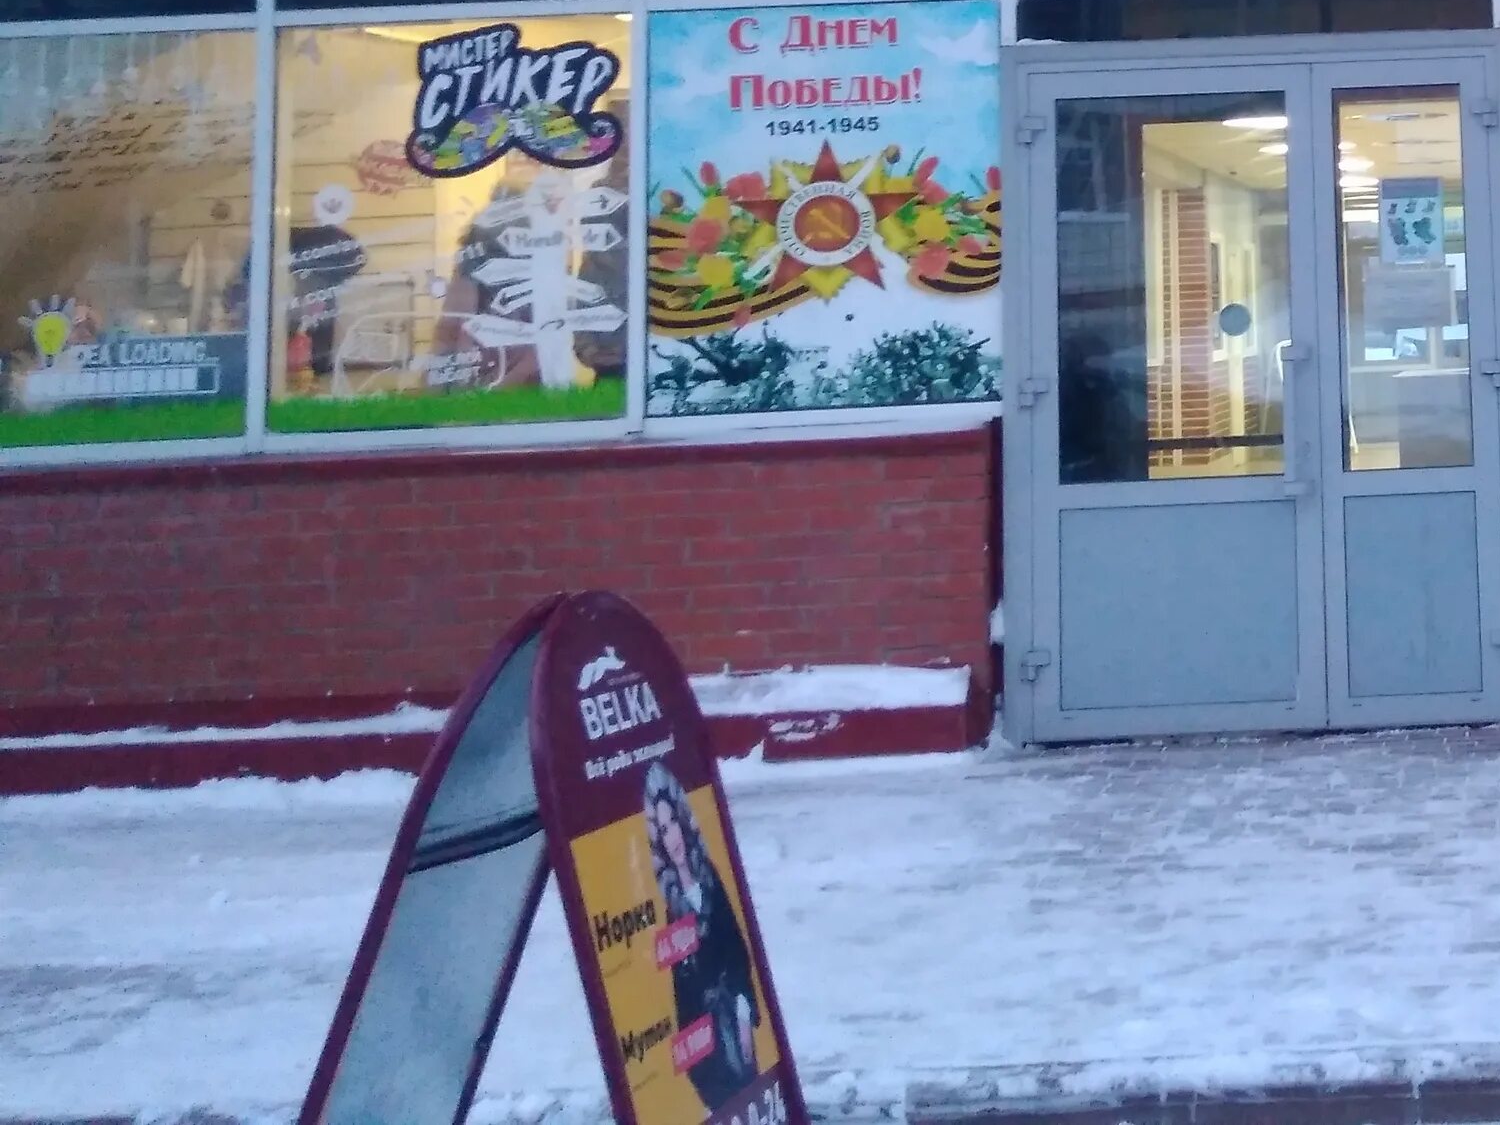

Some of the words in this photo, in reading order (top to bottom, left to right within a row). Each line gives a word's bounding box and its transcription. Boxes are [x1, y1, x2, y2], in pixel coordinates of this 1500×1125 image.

[424, 29, 515, 73] МИСТЕР
[729, 16, 760, 54] С
[420, 48, 613, 129] СТИКЕР
[765, 115, 880, 137] 1941-1945
[580, 681, 662, 740] BELKA
[593, 899, 656, 951] Норка
